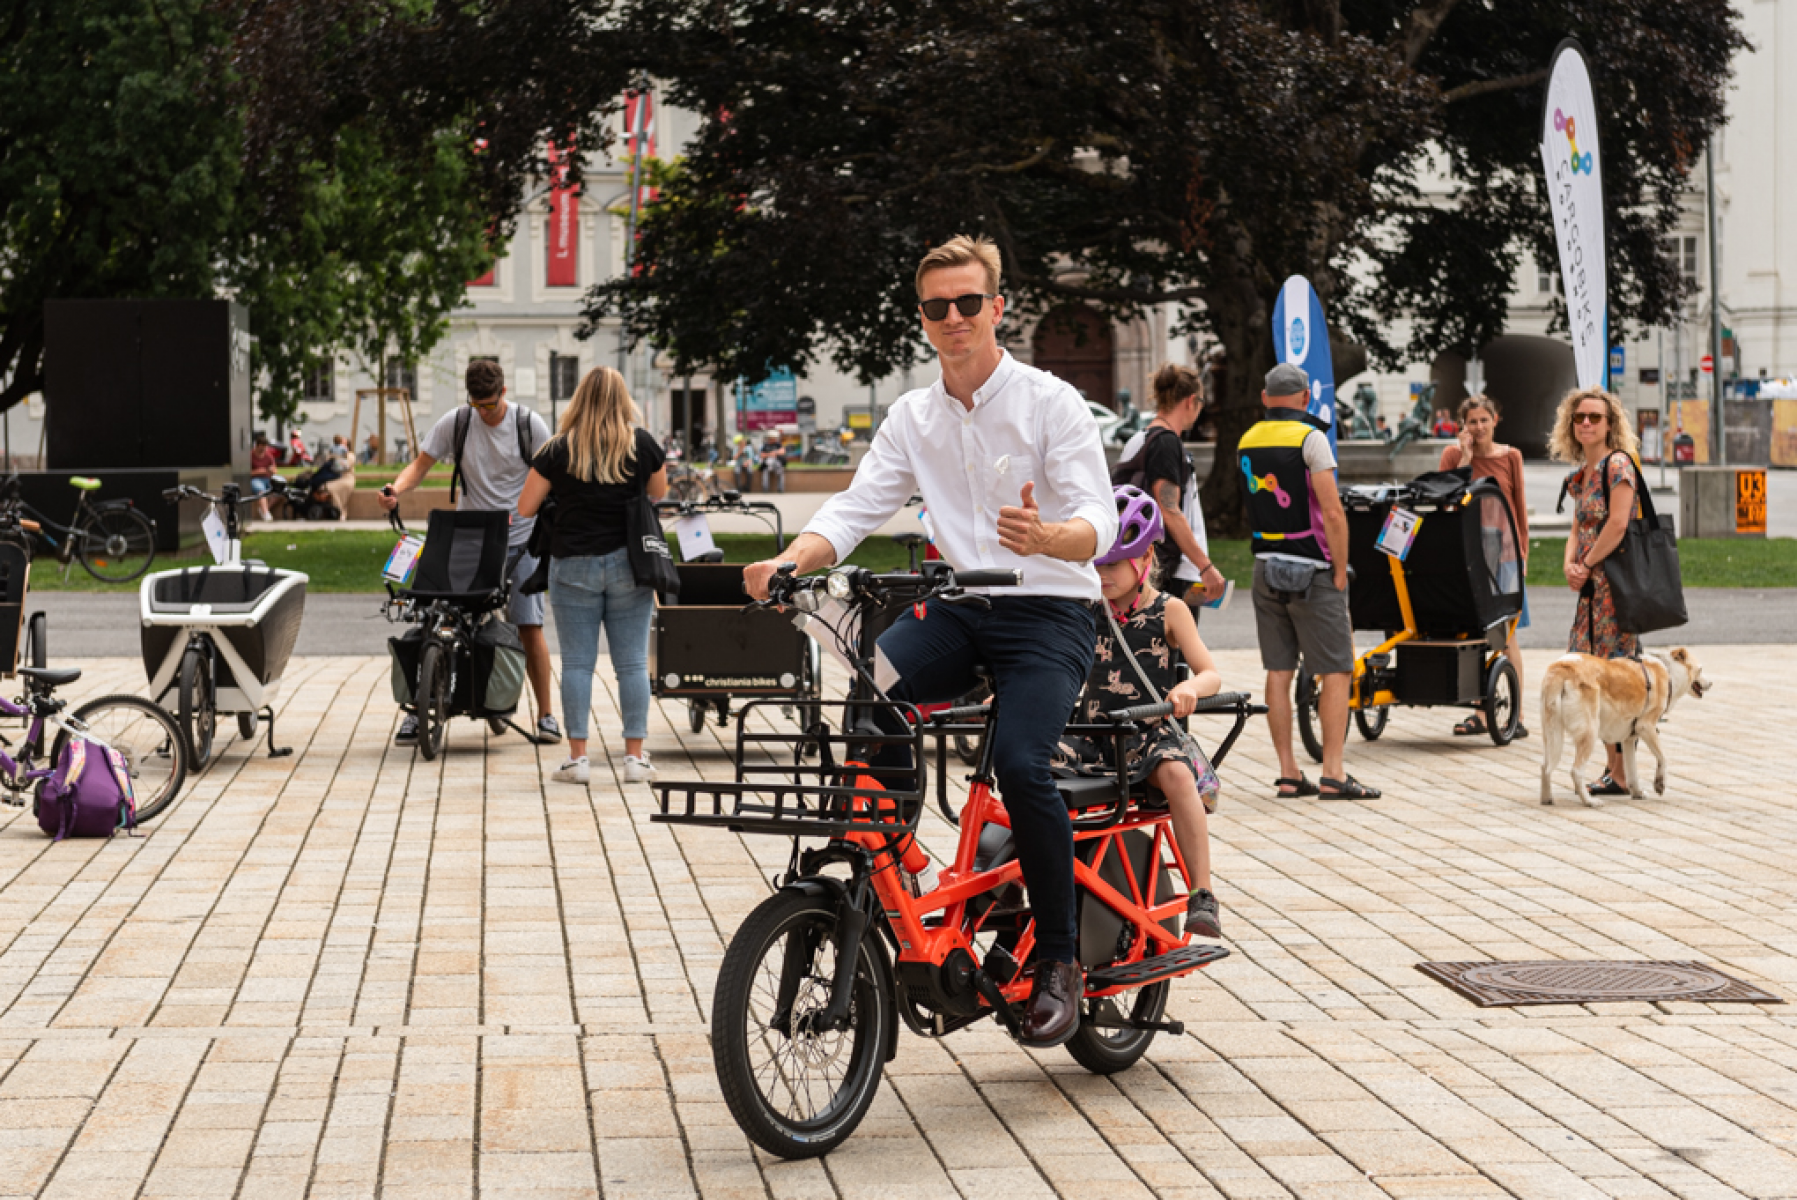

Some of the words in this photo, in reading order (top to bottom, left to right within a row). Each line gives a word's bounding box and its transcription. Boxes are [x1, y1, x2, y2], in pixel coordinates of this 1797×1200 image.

[1560, 159, 1595, 336] CARGOBIKE
[704, 677, 751, 687] christiania
[752, 677, 778, 687] bikes
